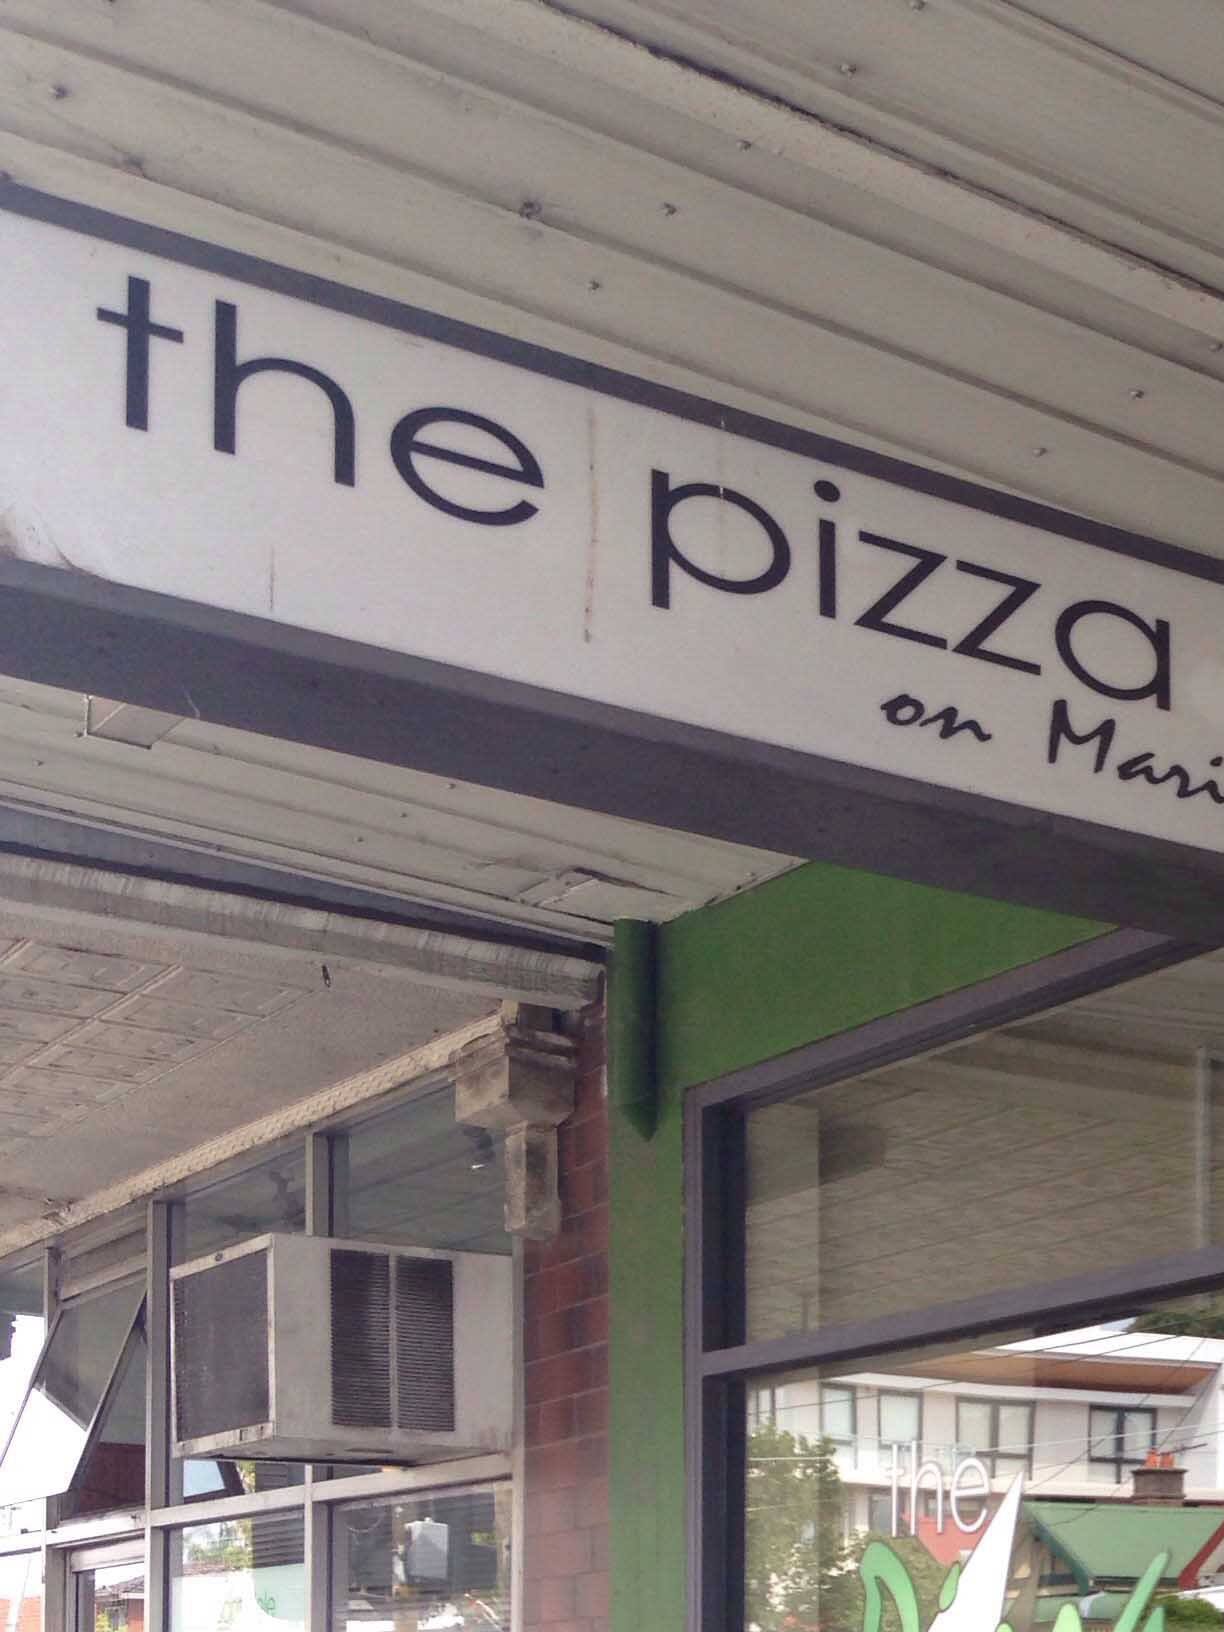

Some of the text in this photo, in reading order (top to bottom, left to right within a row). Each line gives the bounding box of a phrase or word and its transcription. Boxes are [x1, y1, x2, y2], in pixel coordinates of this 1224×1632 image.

[96, 275, 545, 528] the
[650, 468, 1171, 713] pizza
[880, 691, 992, 743] on
[887, 1440, 991, 1538] the
